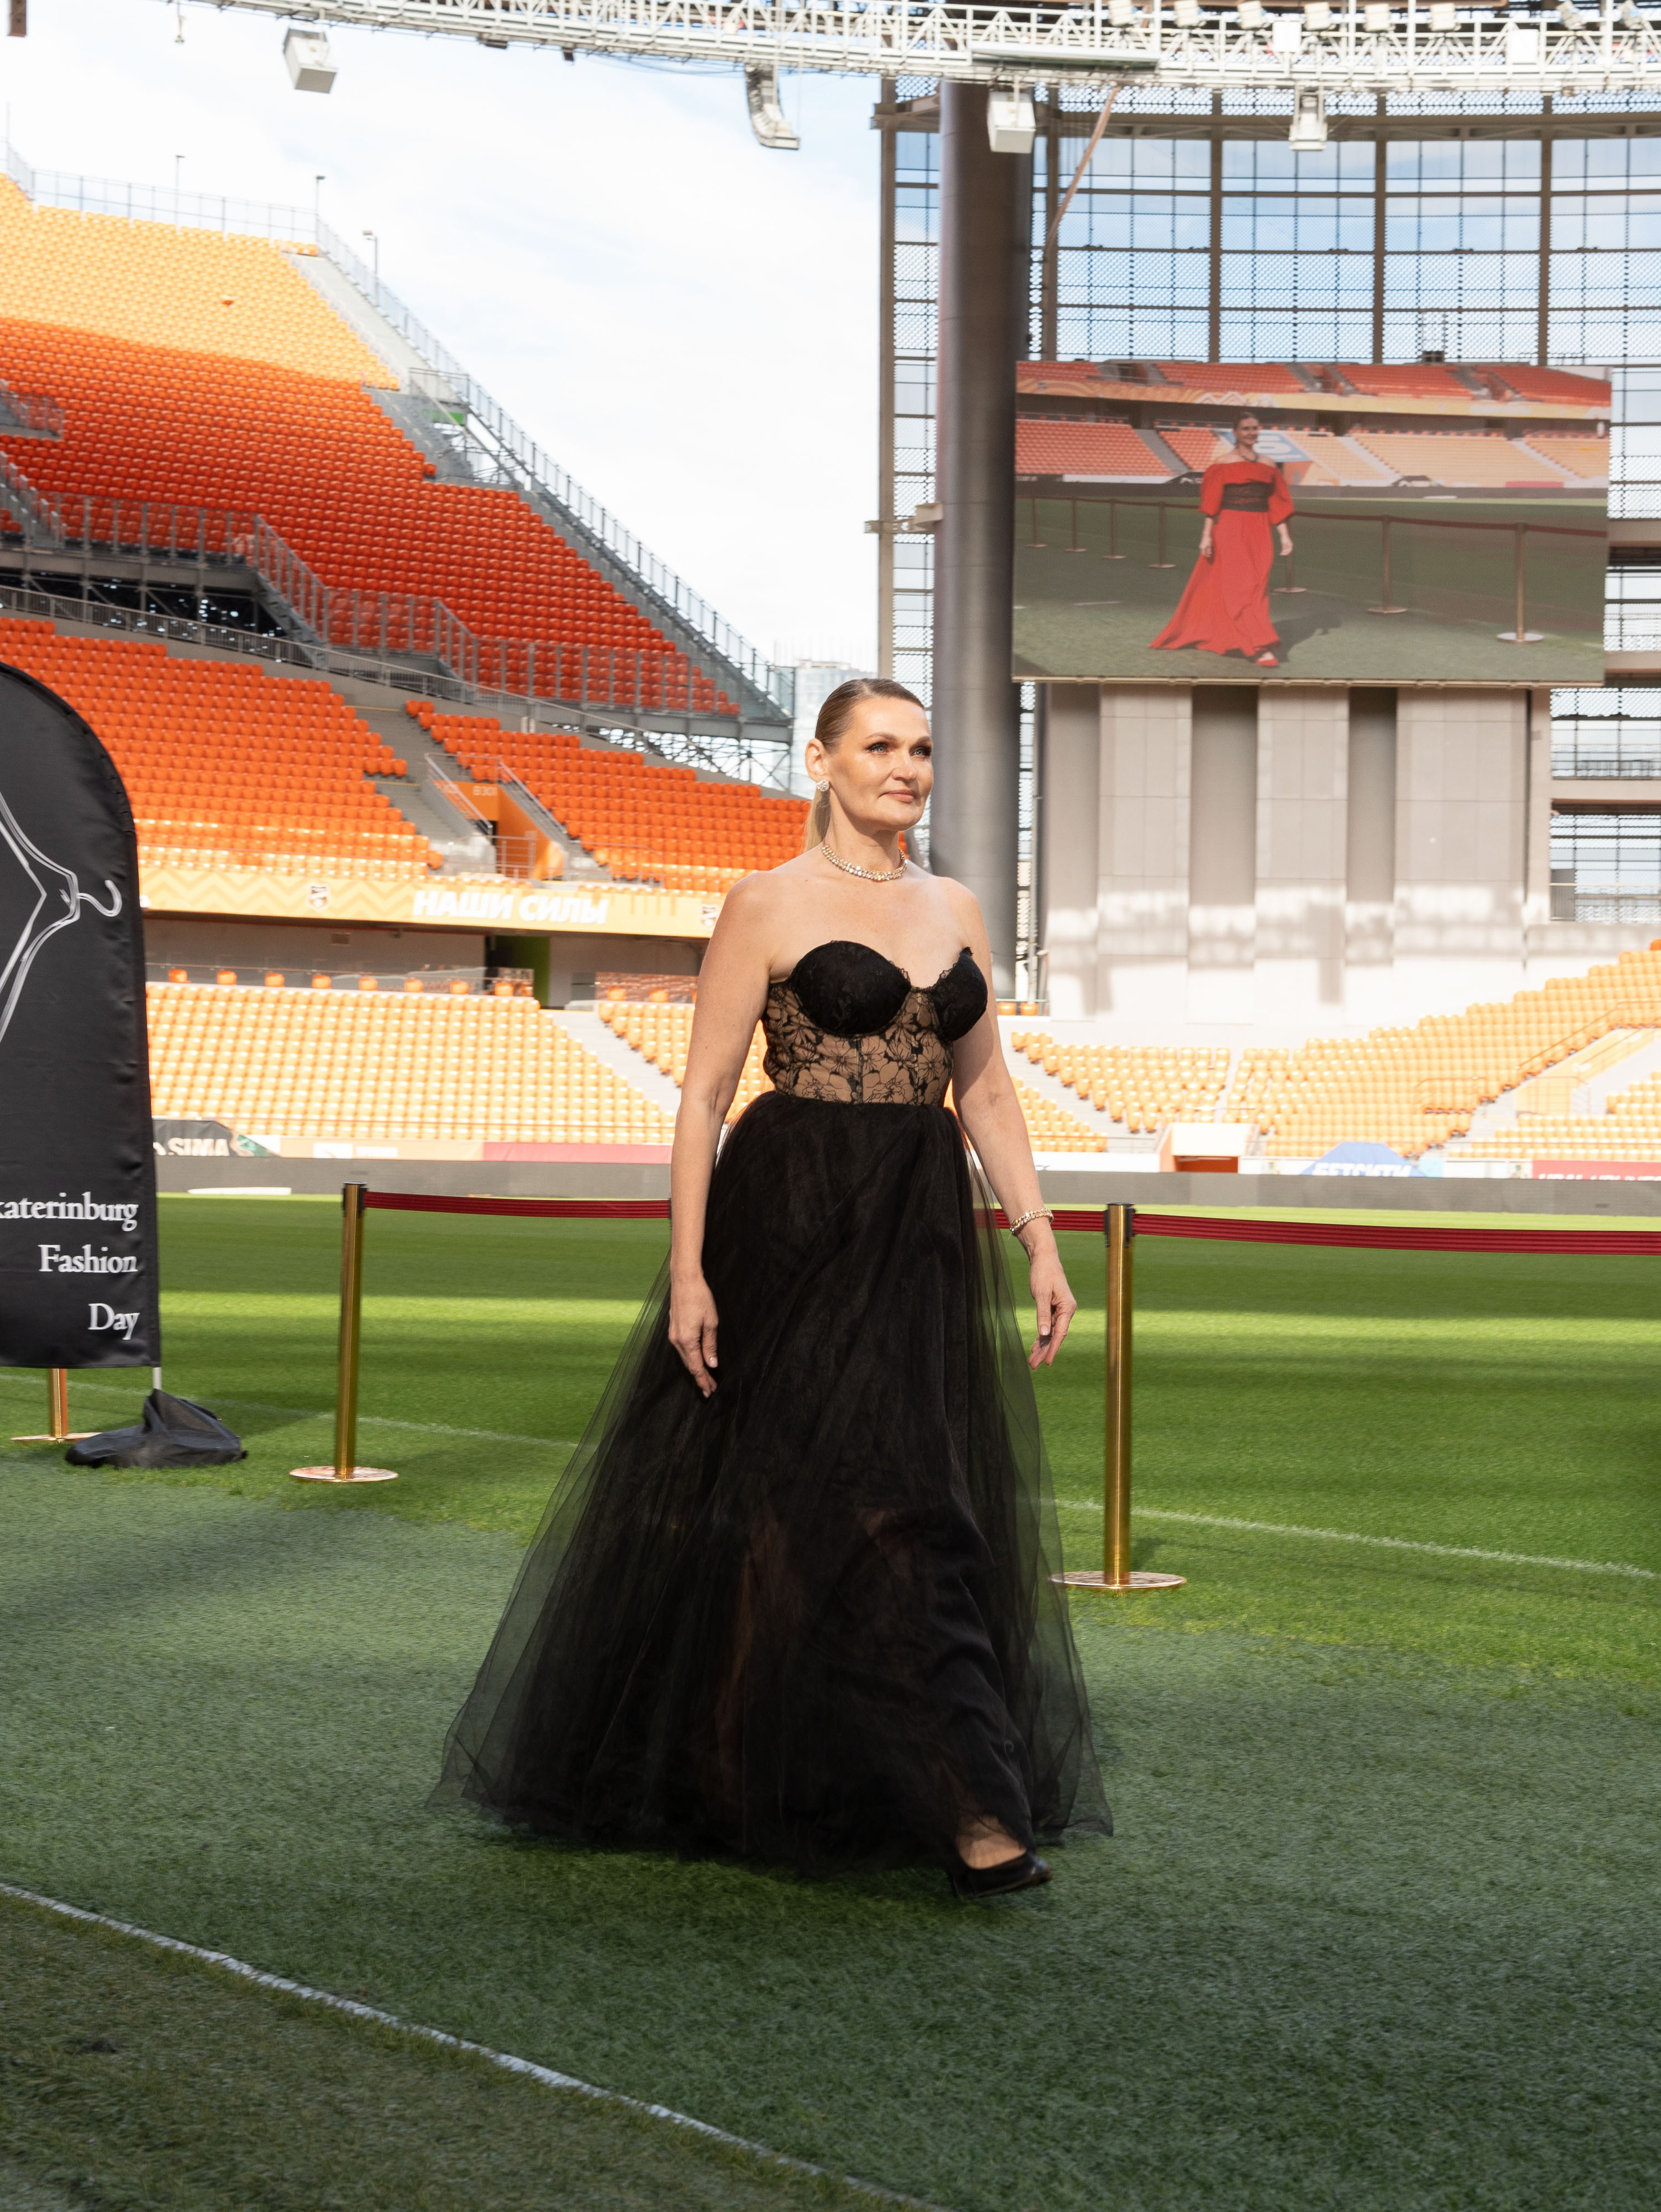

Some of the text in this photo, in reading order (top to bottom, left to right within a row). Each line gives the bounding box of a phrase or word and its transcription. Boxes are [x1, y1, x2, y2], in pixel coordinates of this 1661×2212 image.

[413, 890, 609, 924] НАШИ СИЛЫ
[38, 1244, 138, 1273] Fashion
[88, 1303, 140, 1340] Day
